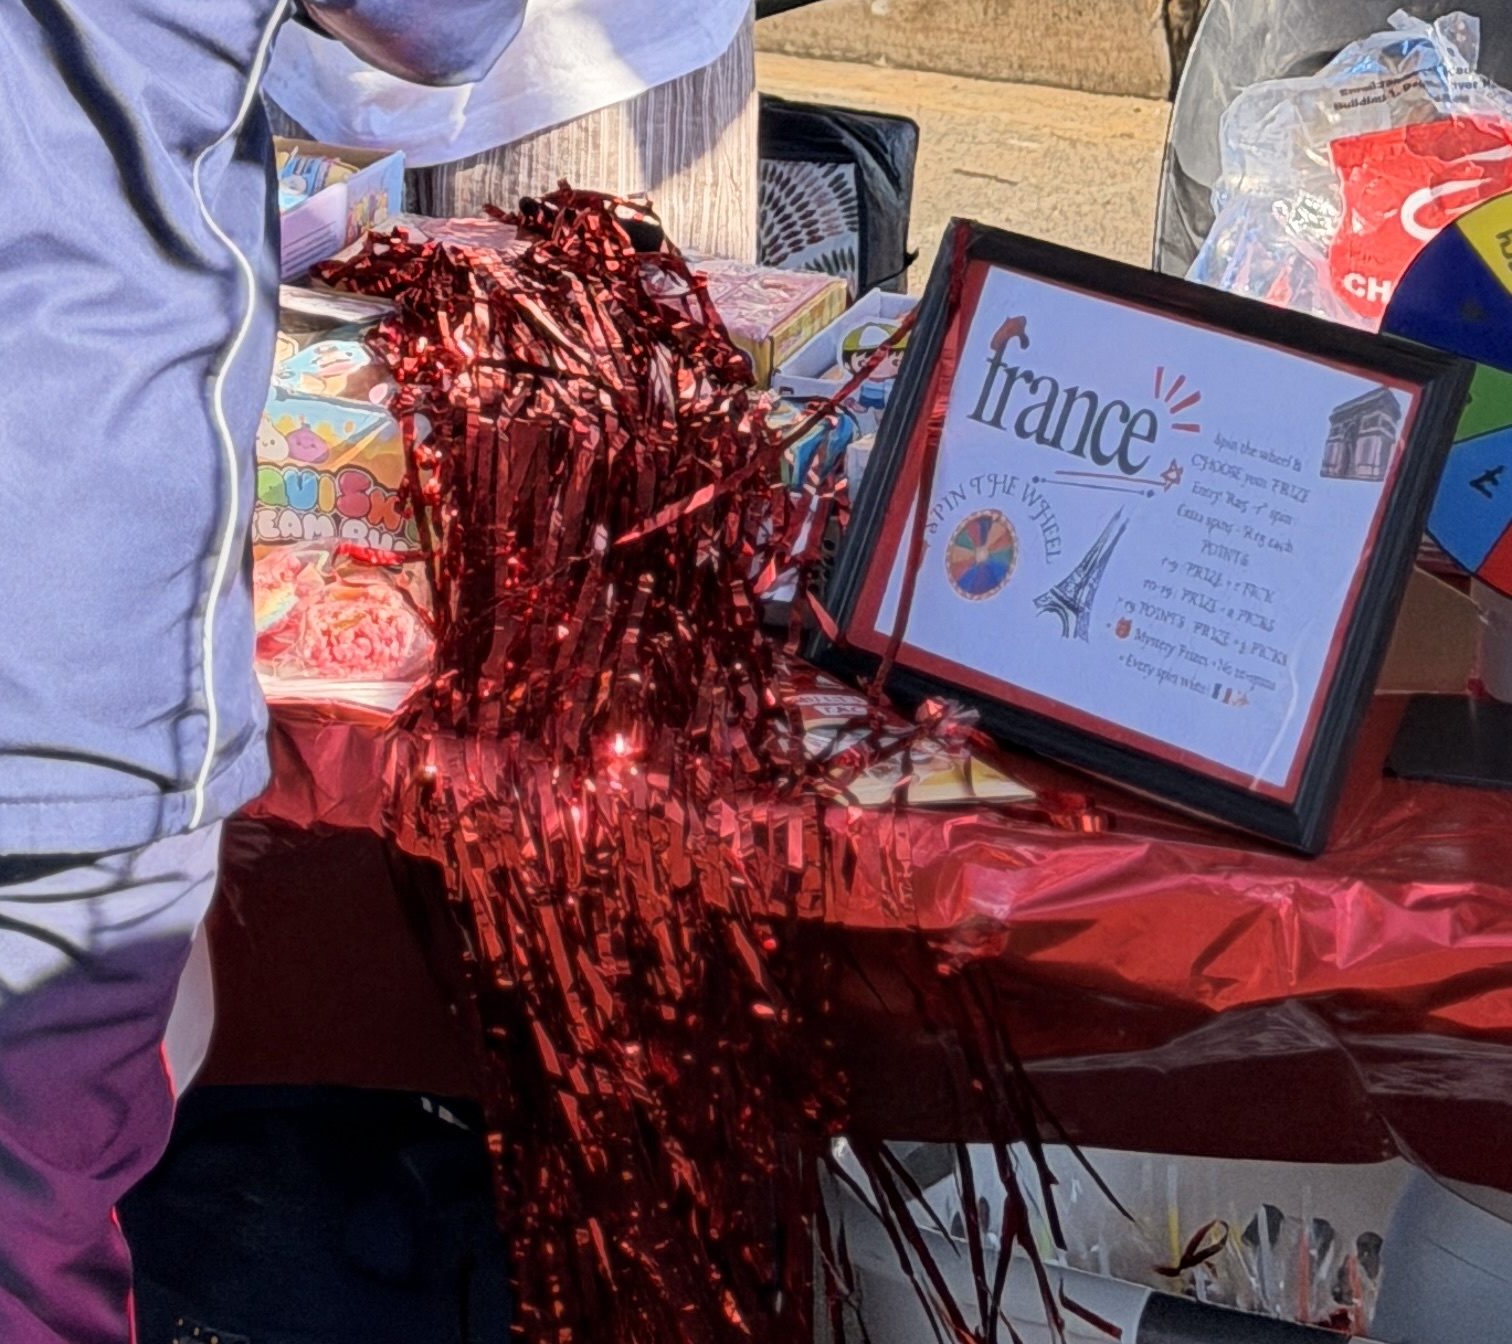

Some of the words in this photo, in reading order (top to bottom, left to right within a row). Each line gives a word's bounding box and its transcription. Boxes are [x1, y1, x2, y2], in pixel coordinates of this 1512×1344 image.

[966, 315, 1159, 476] france
[969, 473, 1020, 499] THE
[1021, 482, 1062, 565] WHEEL
